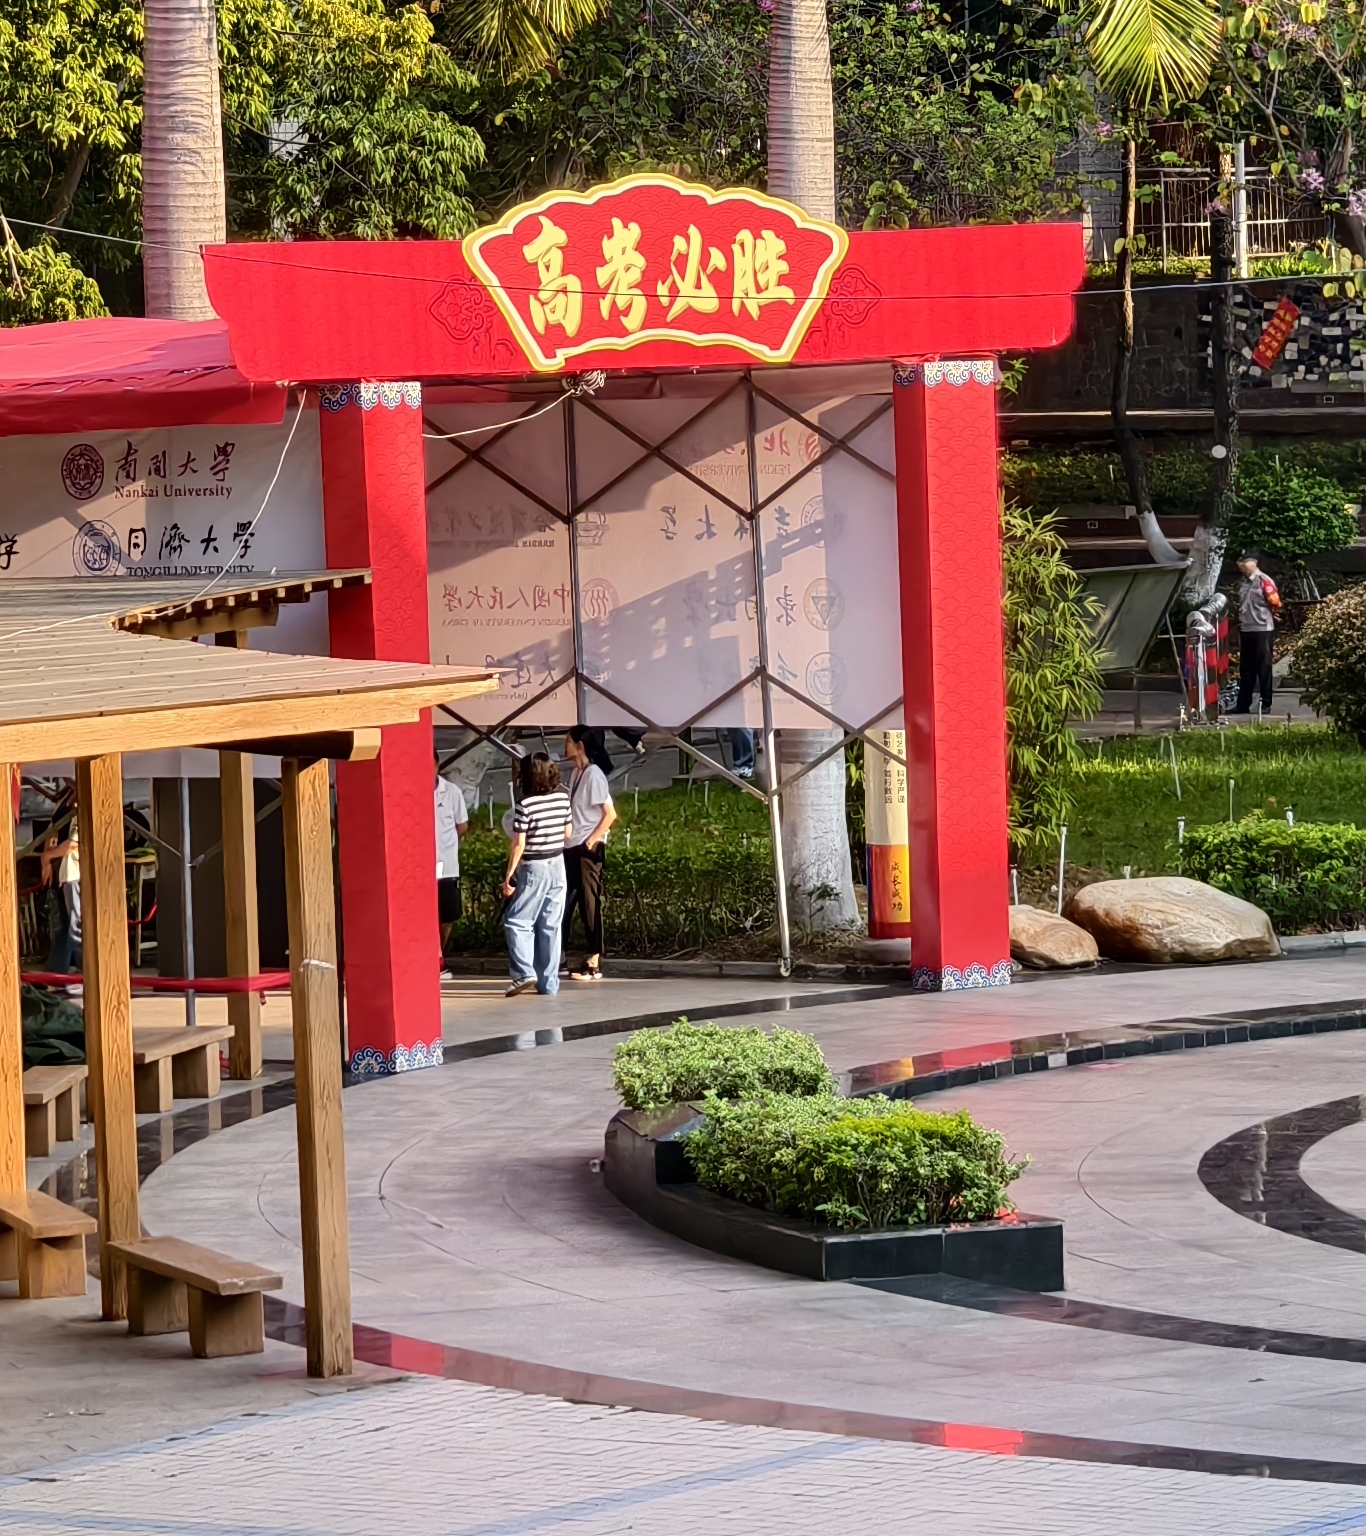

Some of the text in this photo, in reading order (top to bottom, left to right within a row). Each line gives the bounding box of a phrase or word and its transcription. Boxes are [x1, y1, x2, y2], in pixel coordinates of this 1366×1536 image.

[521, 216, 798, 338] 高考必胜
[114, 483, 234, 500] Nankai University
